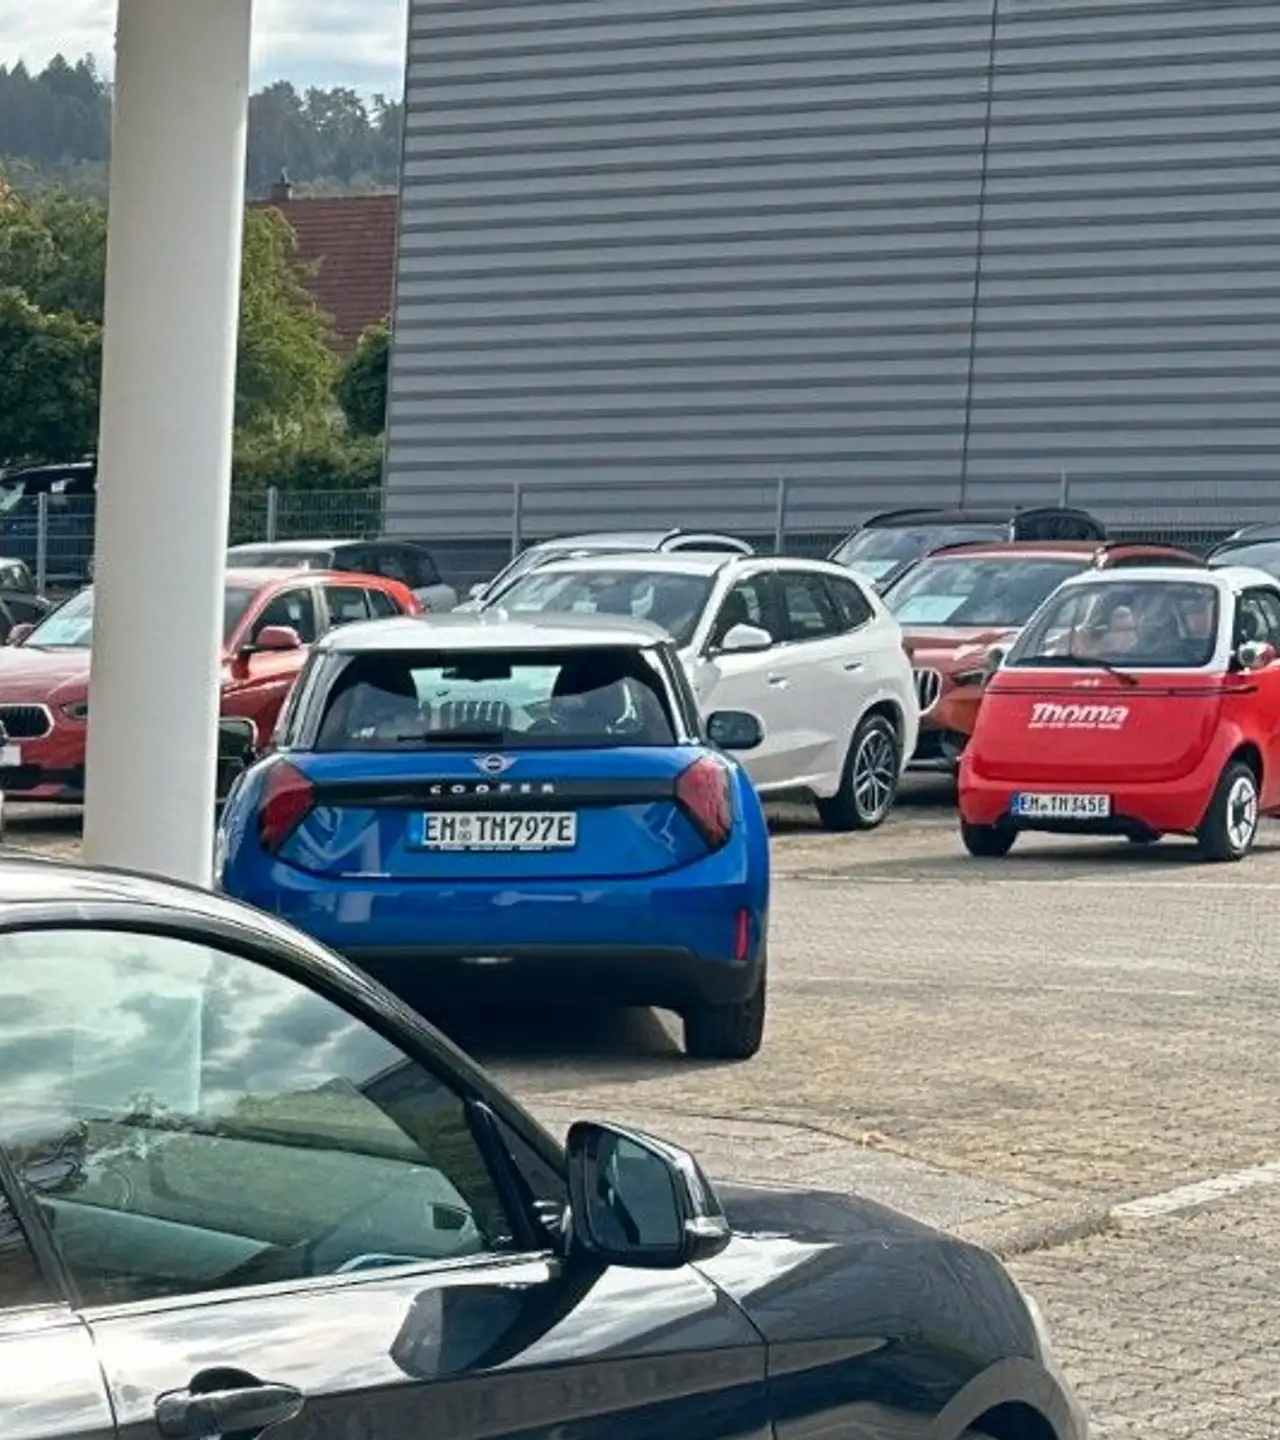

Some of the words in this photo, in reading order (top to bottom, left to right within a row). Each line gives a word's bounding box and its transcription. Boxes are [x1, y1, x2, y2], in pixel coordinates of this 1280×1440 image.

[1031, 703, 1129, 722] Thoma
[430, 783, 554, 794] COOPER
[425, 816, 456, 841] EM
